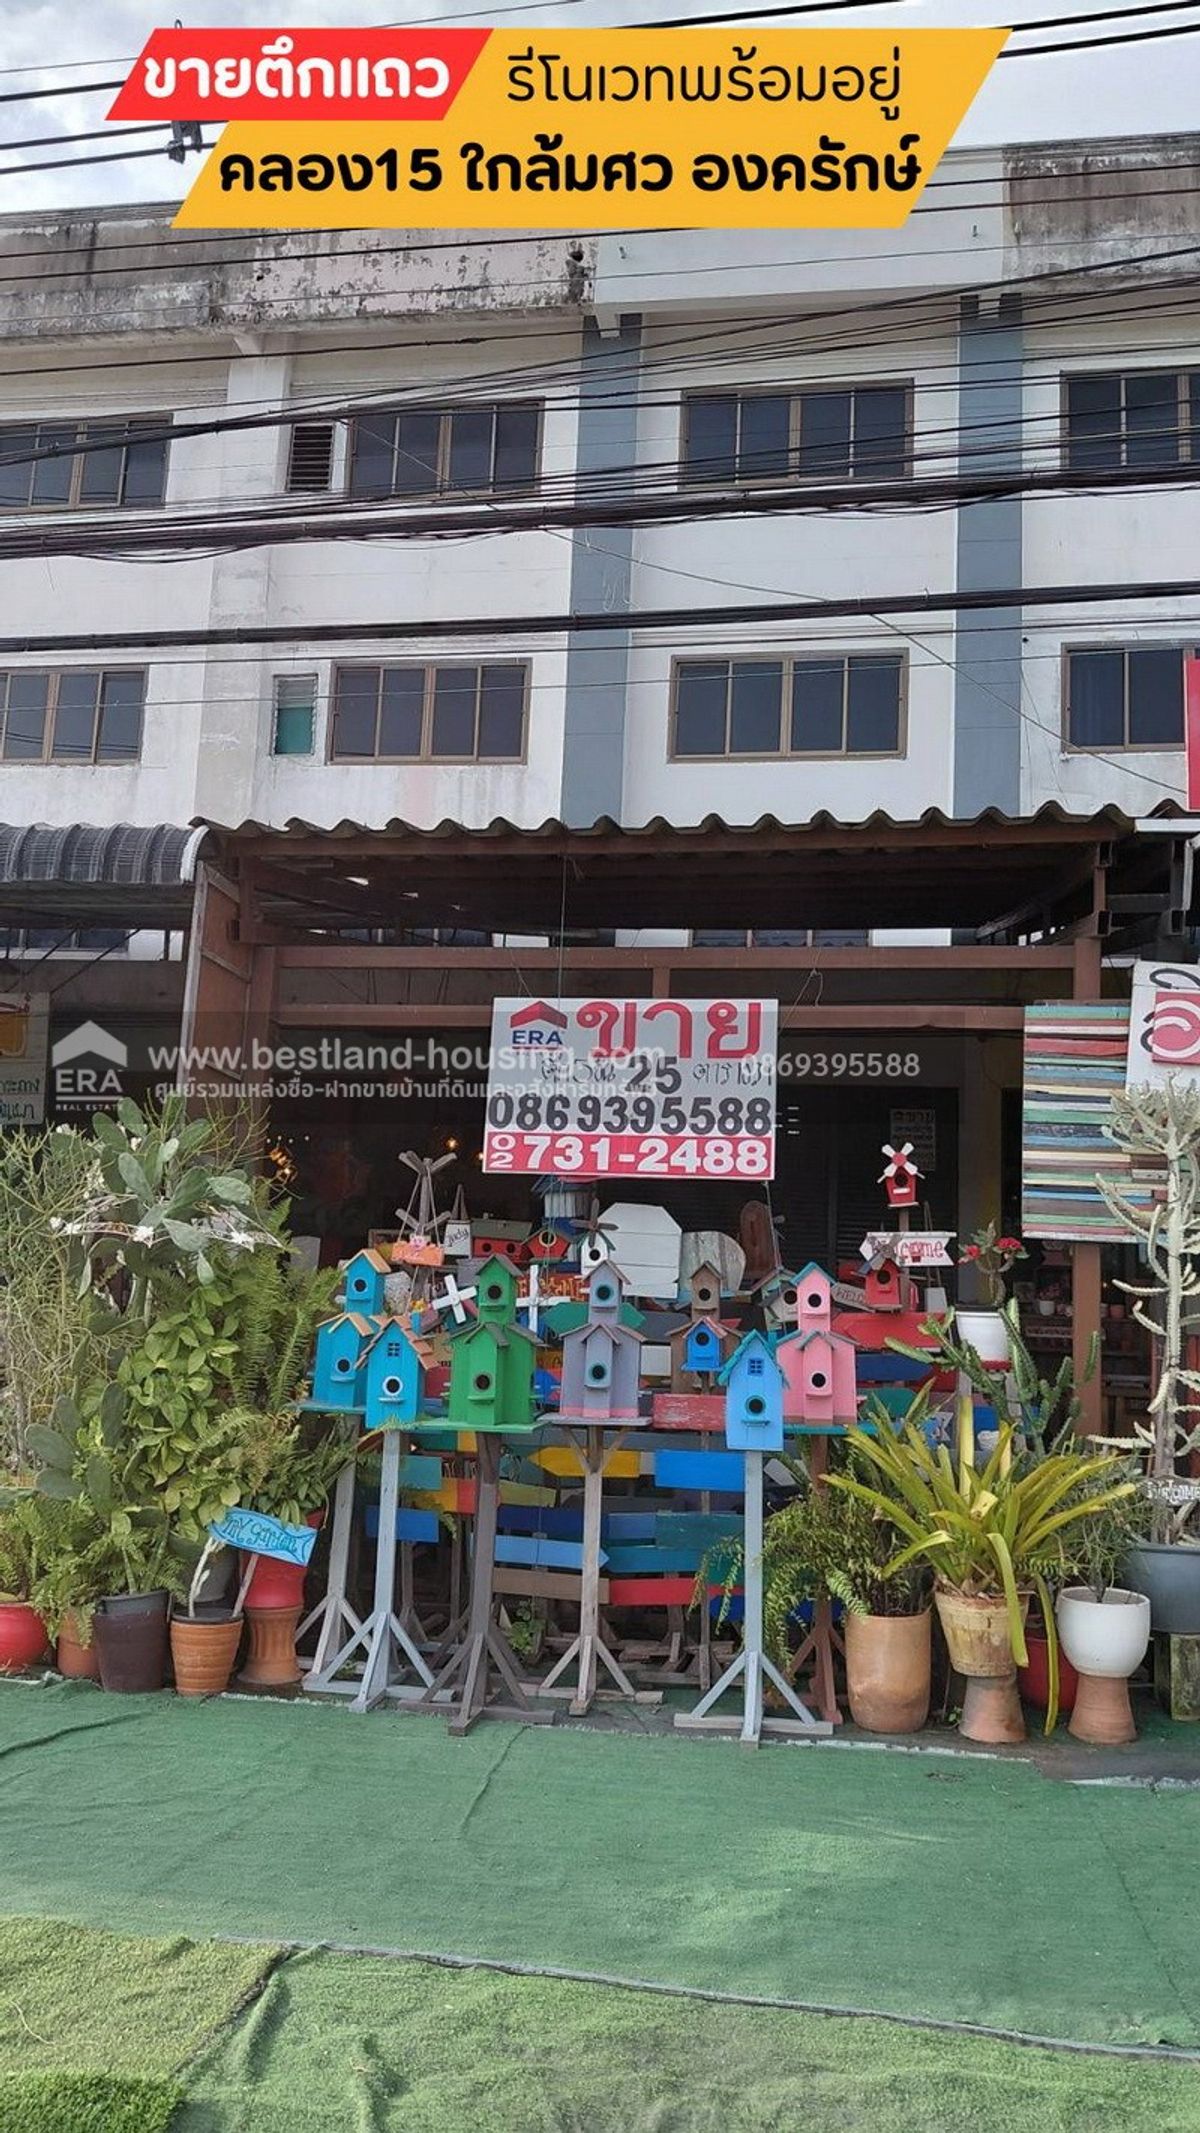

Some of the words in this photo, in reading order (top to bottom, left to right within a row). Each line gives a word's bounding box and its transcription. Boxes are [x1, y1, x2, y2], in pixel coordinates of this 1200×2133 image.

[512, 1030, 563, 1045] ERA
[577, 1001, 762, 1058] ขาย
[626, 1056, 682, 1095] 25
[488, 1096, 772, 1136] 0869395588
[523, 1135, 769, 1175] 731-2488
